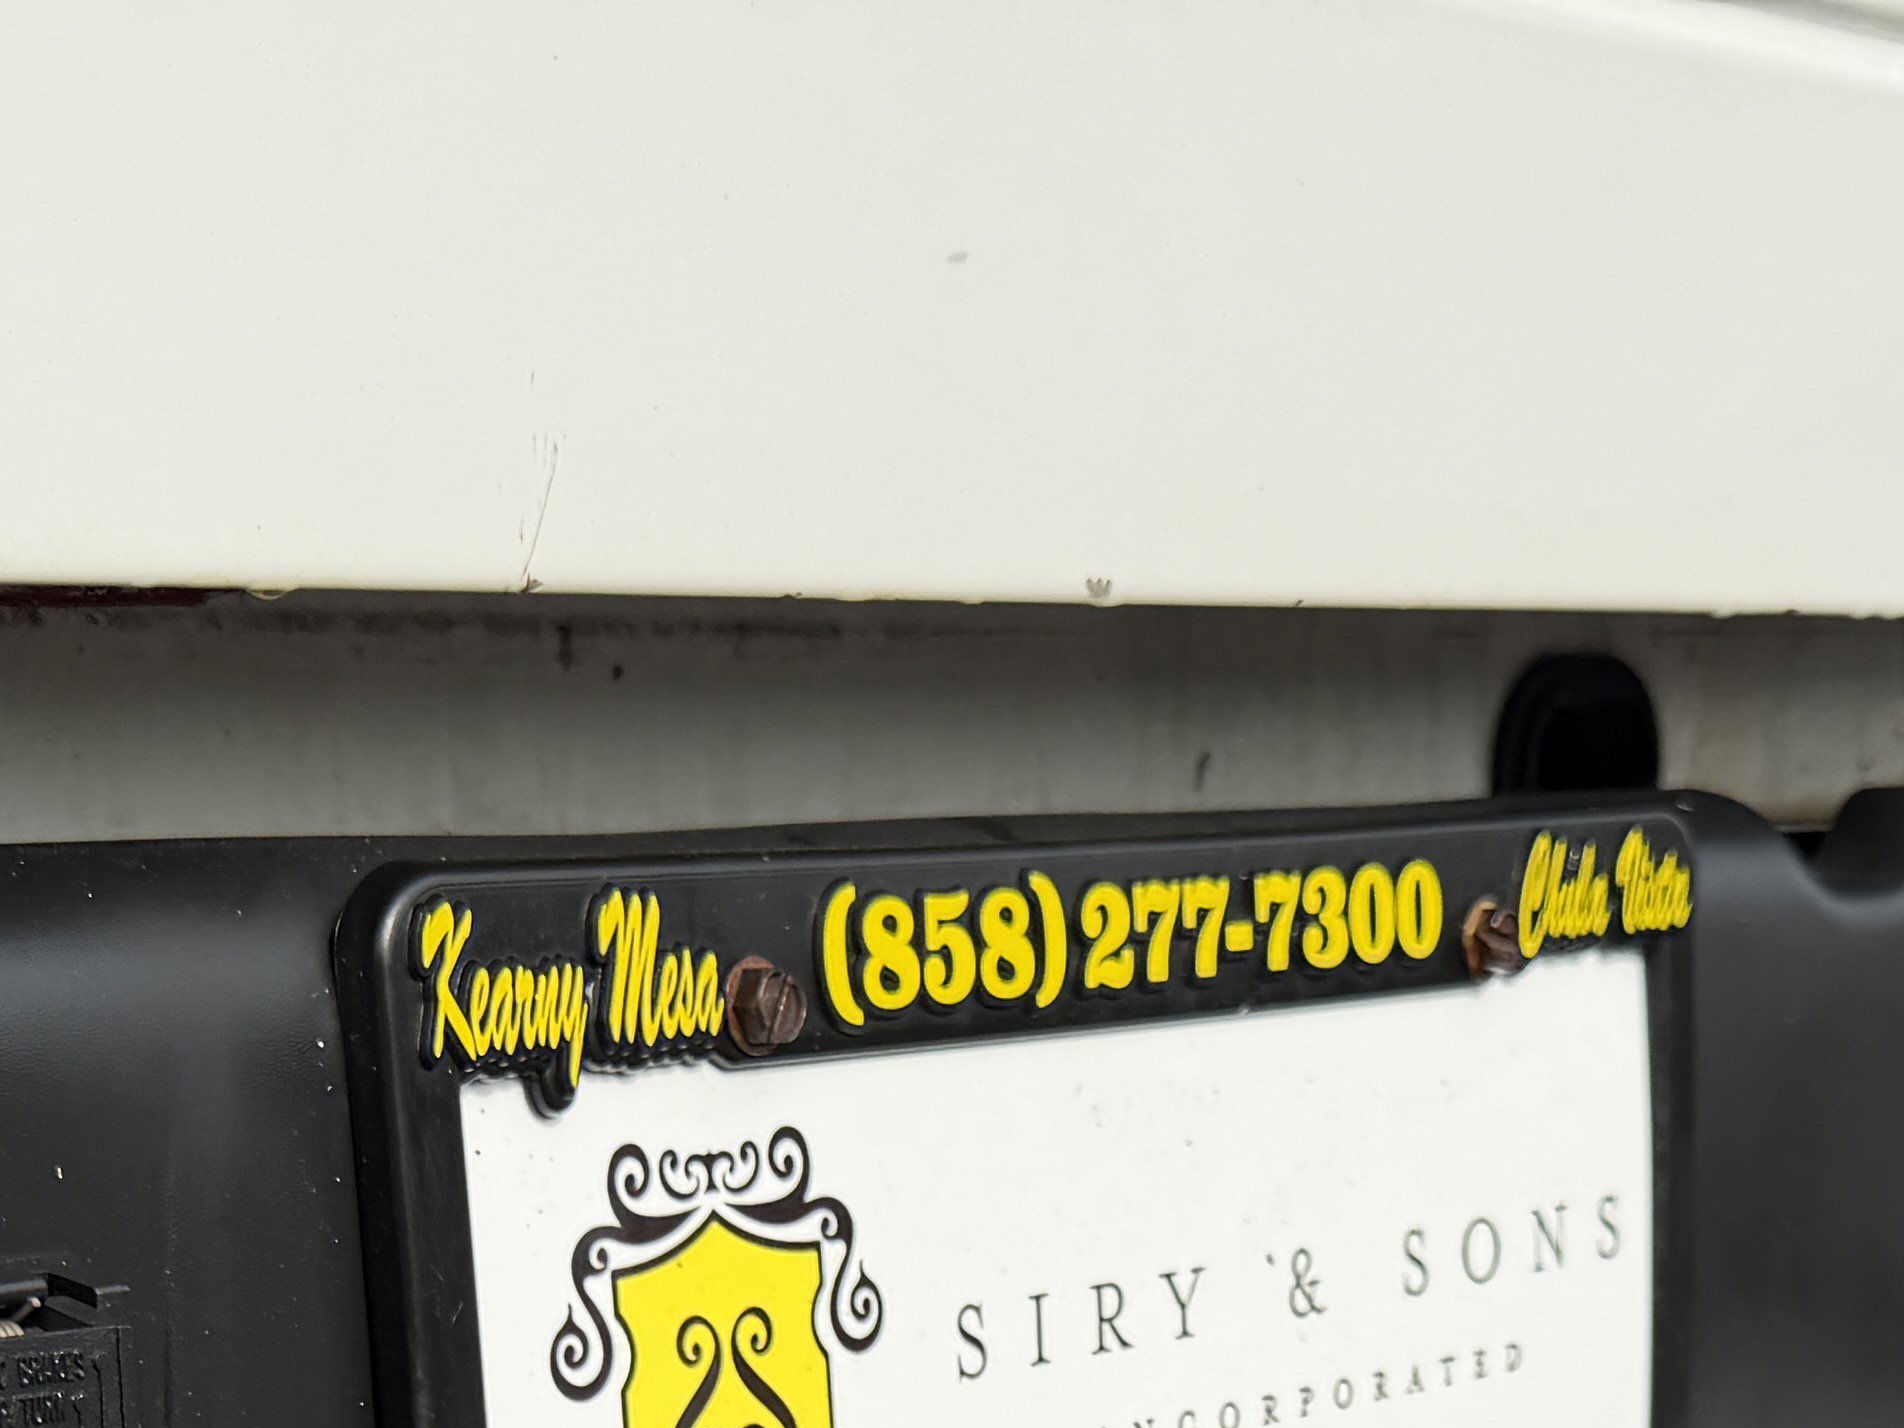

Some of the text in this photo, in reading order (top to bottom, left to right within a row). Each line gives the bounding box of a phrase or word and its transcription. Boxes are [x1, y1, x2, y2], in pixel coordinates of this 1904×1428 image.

[422, 886, 725, 1088] Kearny Mesa
[823, 859, 1443, 1026] (858) 277-7300
[956, 1194, 1622, 1381] SIRY & SONS
